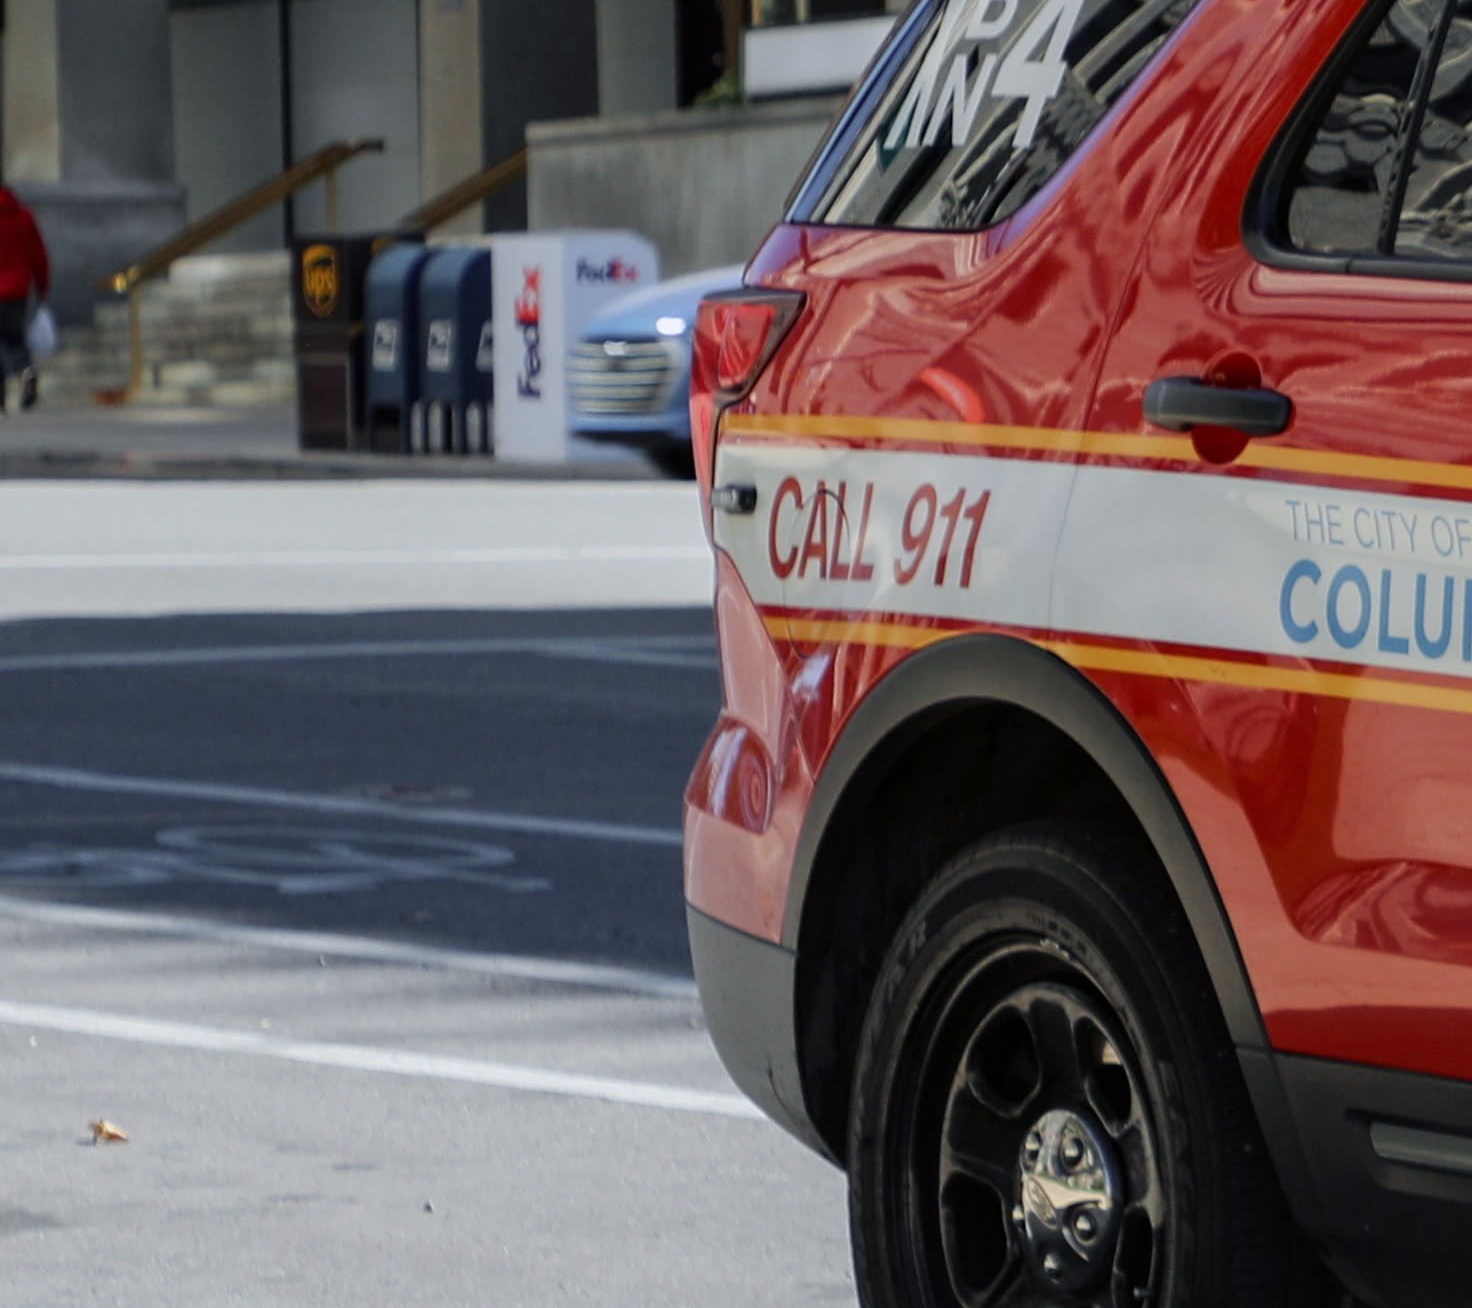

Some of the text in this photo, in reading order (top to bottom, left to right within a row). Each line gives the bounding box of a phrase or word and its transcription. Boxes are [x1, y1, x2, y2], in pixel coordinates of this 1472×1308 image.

[577, 257, 639, 283] FedEx
[515, 265, 542, 400] FedEx
[768, 475, 992, 590] CALL 911
[1285, 499, 1472, 559] THE CITY OF
